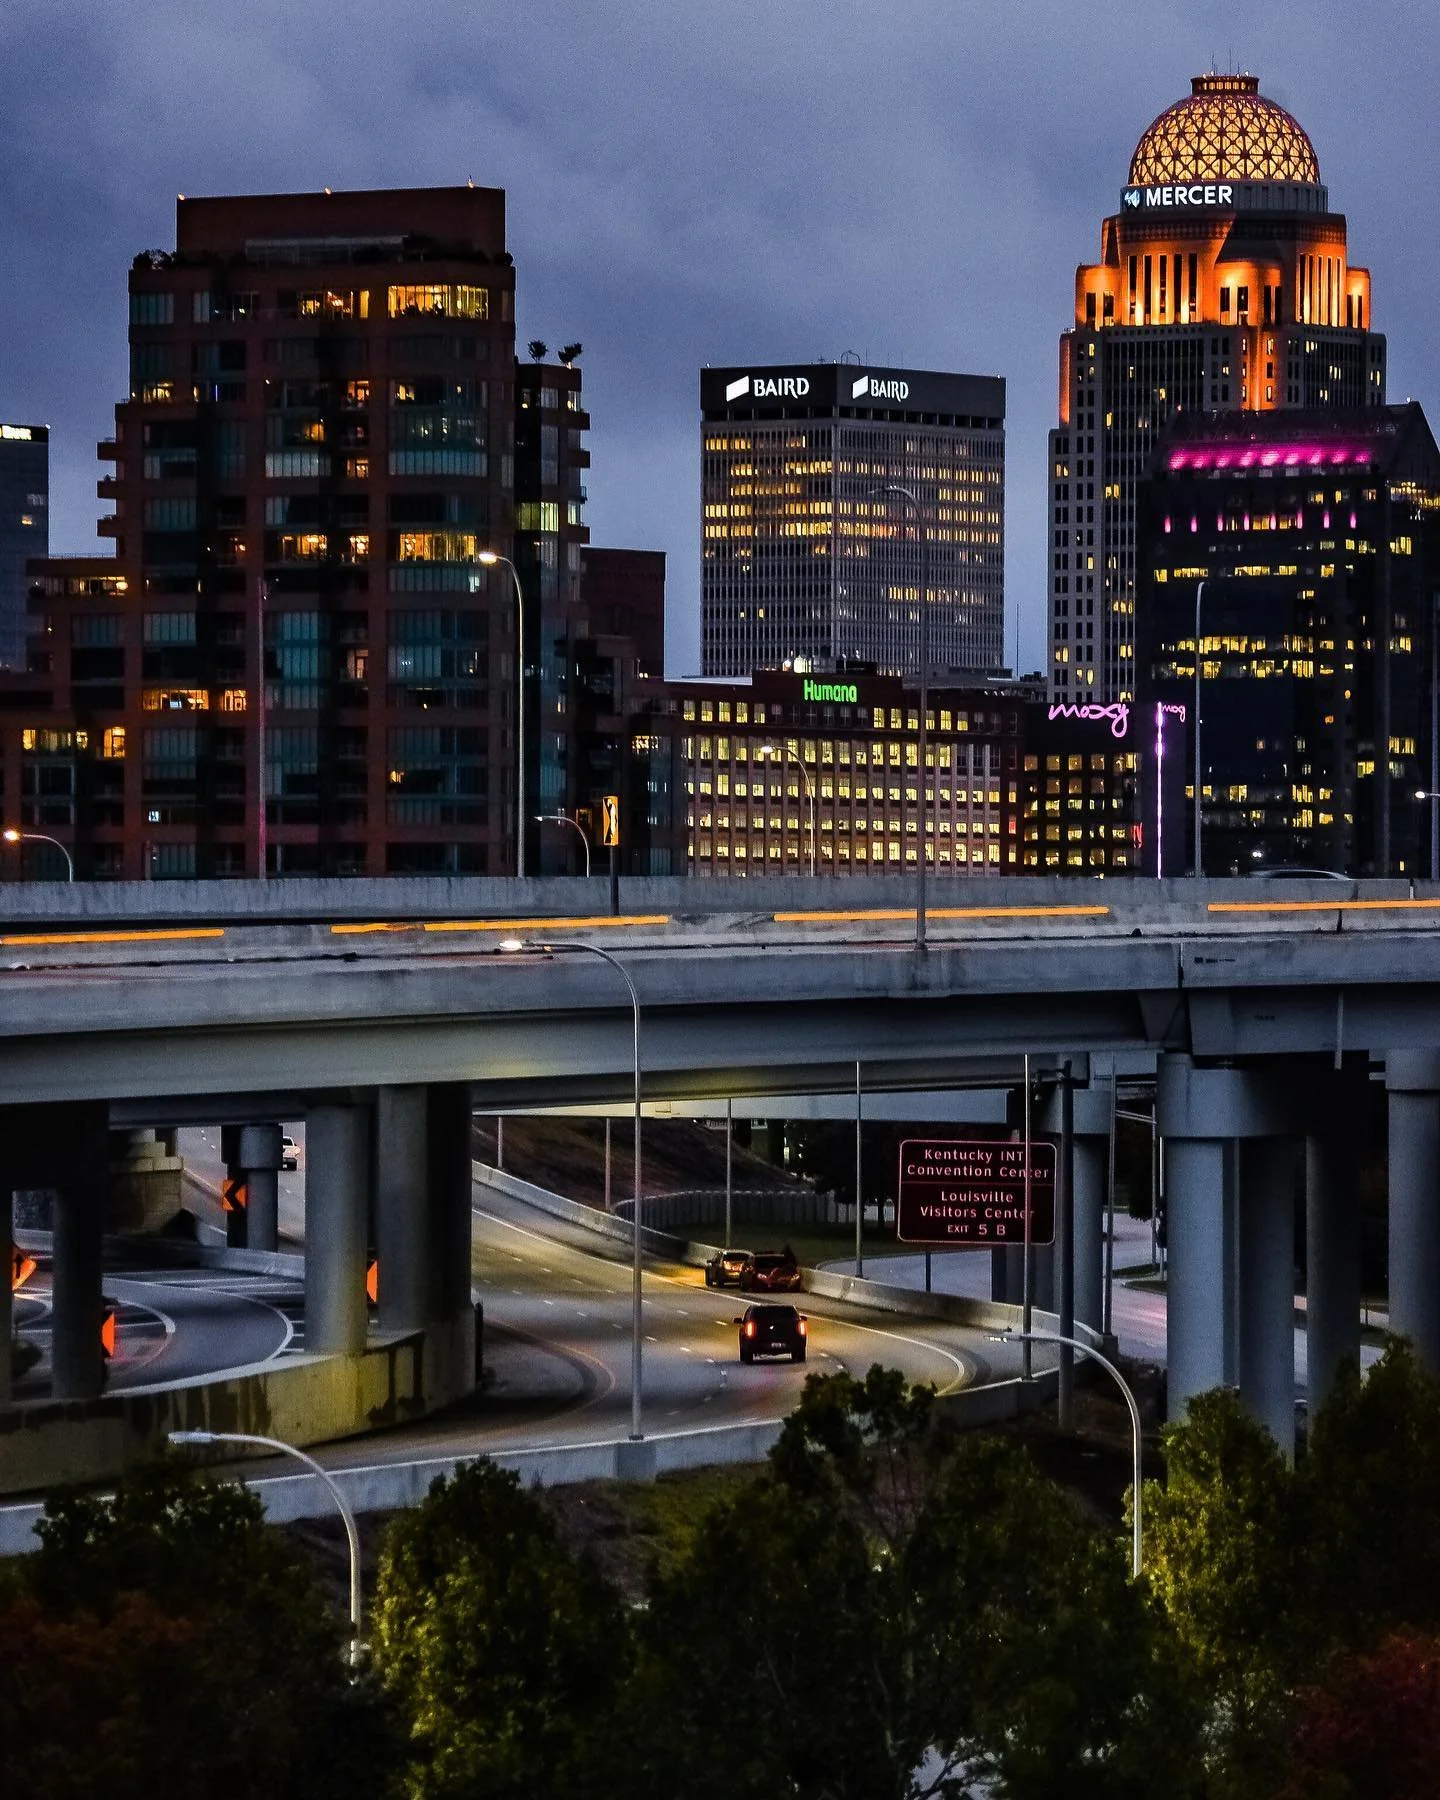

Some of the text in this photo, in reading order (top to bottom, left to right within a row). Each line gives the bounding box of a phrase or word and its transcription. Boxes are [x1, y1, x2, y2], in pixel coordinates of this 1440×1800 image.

[1146, 185, 1233, 207] MERCER
[753, 377, 810, 399] BAIRD
[870, 379, 909, 402] BAIRD
[803, 679, 858, 702] Humana
[1048, 703, 1130, 738] moxy
[924, 1148, 1024, 1164] Kentucky INT
[907, 1164, 1049, 1179] Convention Cener
[941, 1190, 1014, 1203] Louisville
[920, 1206, 977, 1219] Visitors
[947, 1223, 1006, 1236] EXIT 5 B
